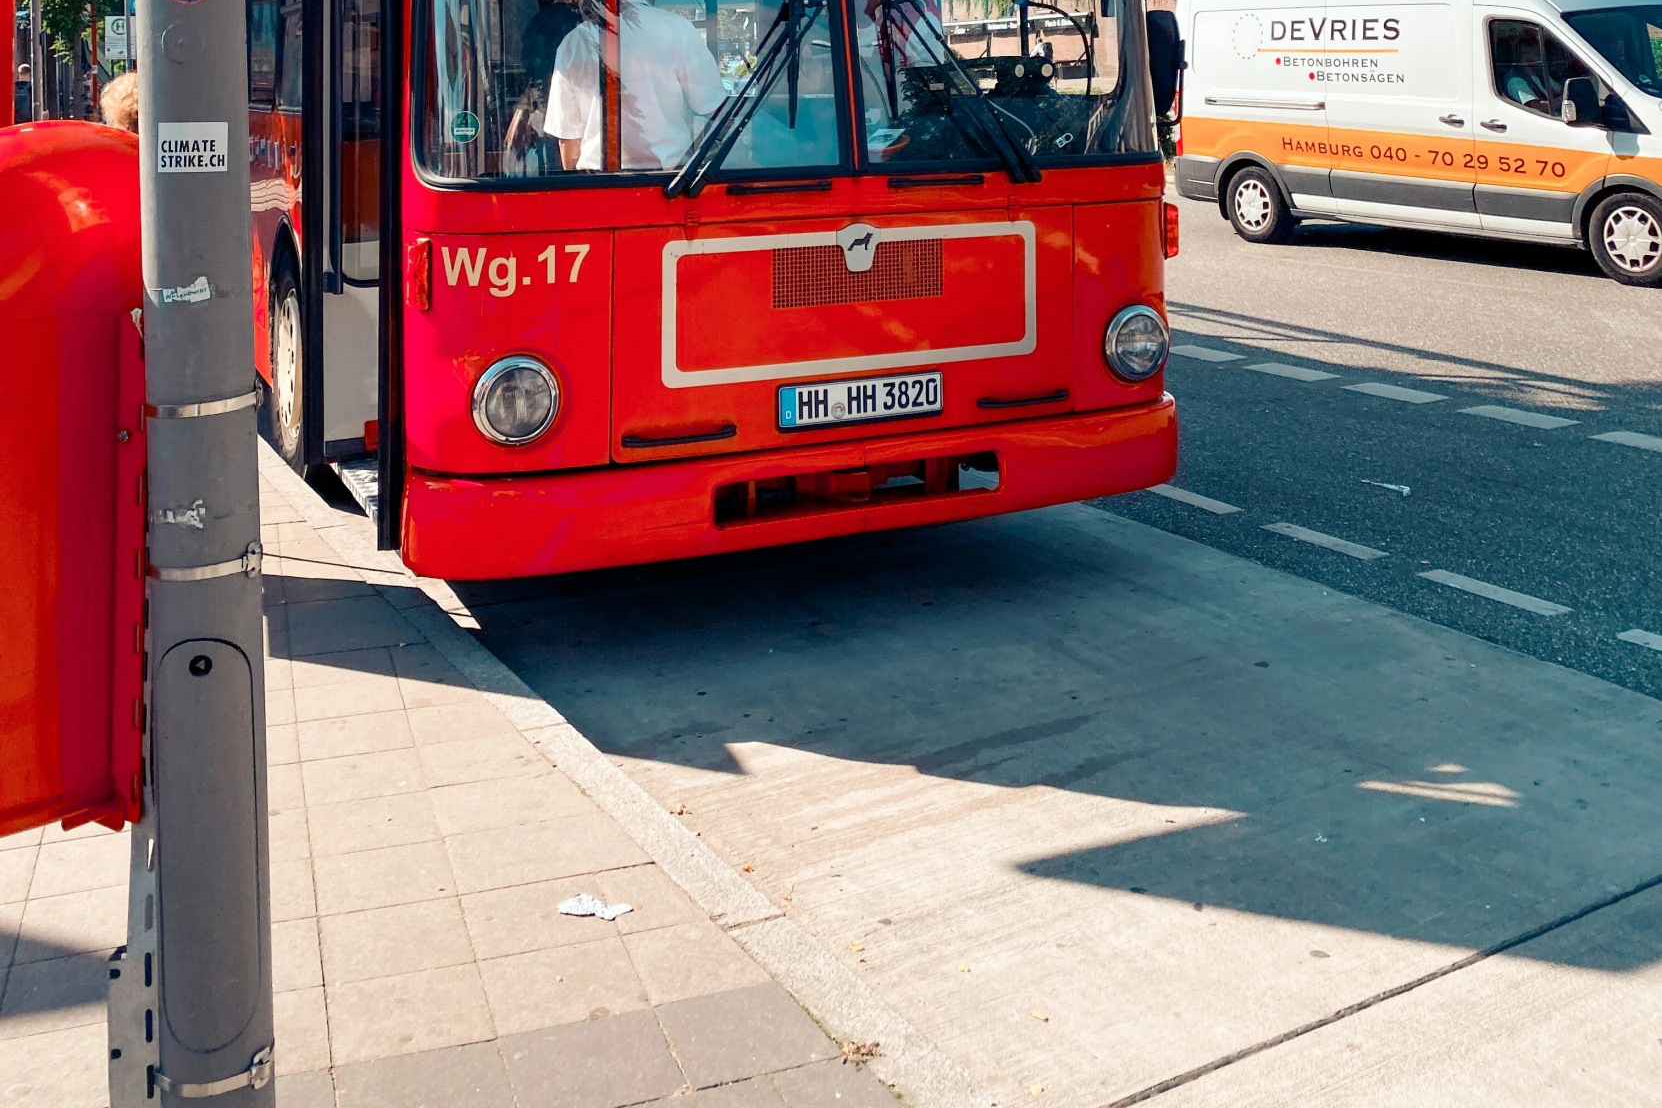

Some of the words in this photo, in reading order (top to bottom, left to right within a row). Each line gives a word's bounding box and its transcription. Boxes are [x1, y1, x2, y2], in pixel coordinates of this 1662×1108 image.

[161, 139, 216, 153] CLIMATE
[1281, 136, 1363, 158] HAMBURG
[1370, 145, 1407, 162] 040
[1427, 149, 1454, 167] 70
[1463, 153, 1489, 170] 29
[1499, 156, 1527, 174] 52
[1535, 159, 1566, 178] 70
[161, 154, 225, 168] STRIKE.CH
[441, 244, 591, 298] Wg.17
[798, 388, 829, 420] HH
[847, 383, 877, 415] HH
[883, 377, 938, 412] 3820
[785, 410, 792, 419] D
